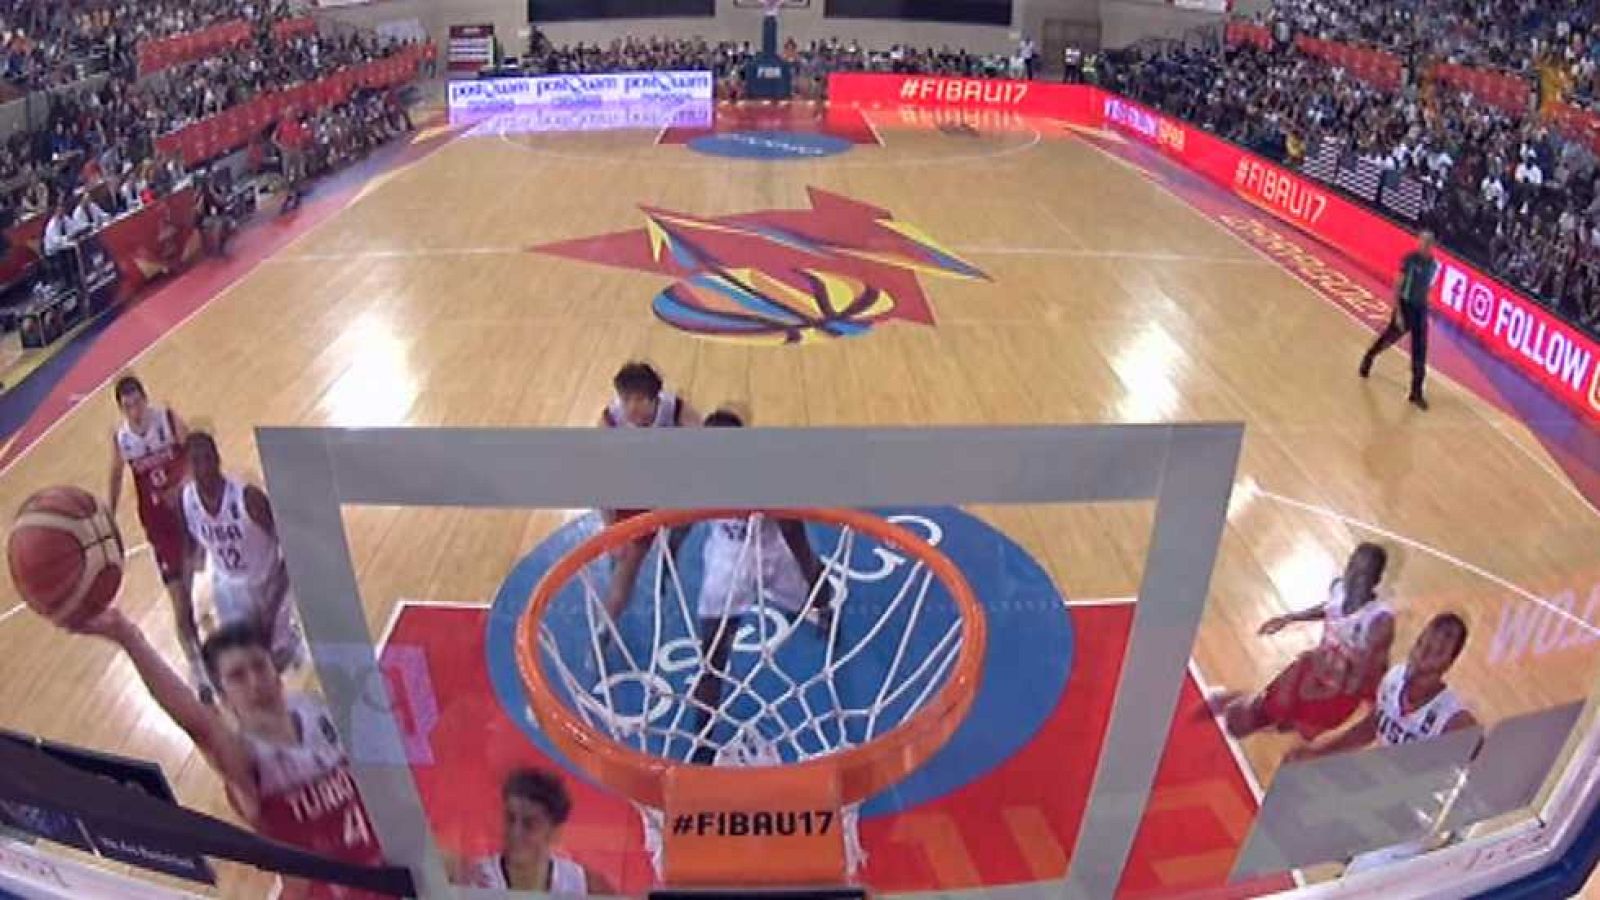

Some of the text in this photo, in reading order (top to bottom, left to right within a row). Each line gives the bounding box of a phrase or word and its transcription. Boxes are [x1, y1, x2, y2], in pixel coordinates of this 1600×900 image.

[900, 79, 1028, 105] #FIBAU17
[1234, 156, 1327, 224] #FIBAU17
[1493, 298, 1591, 391] FOLLOW
[673, 811, 833, 836] #FIBAU17
